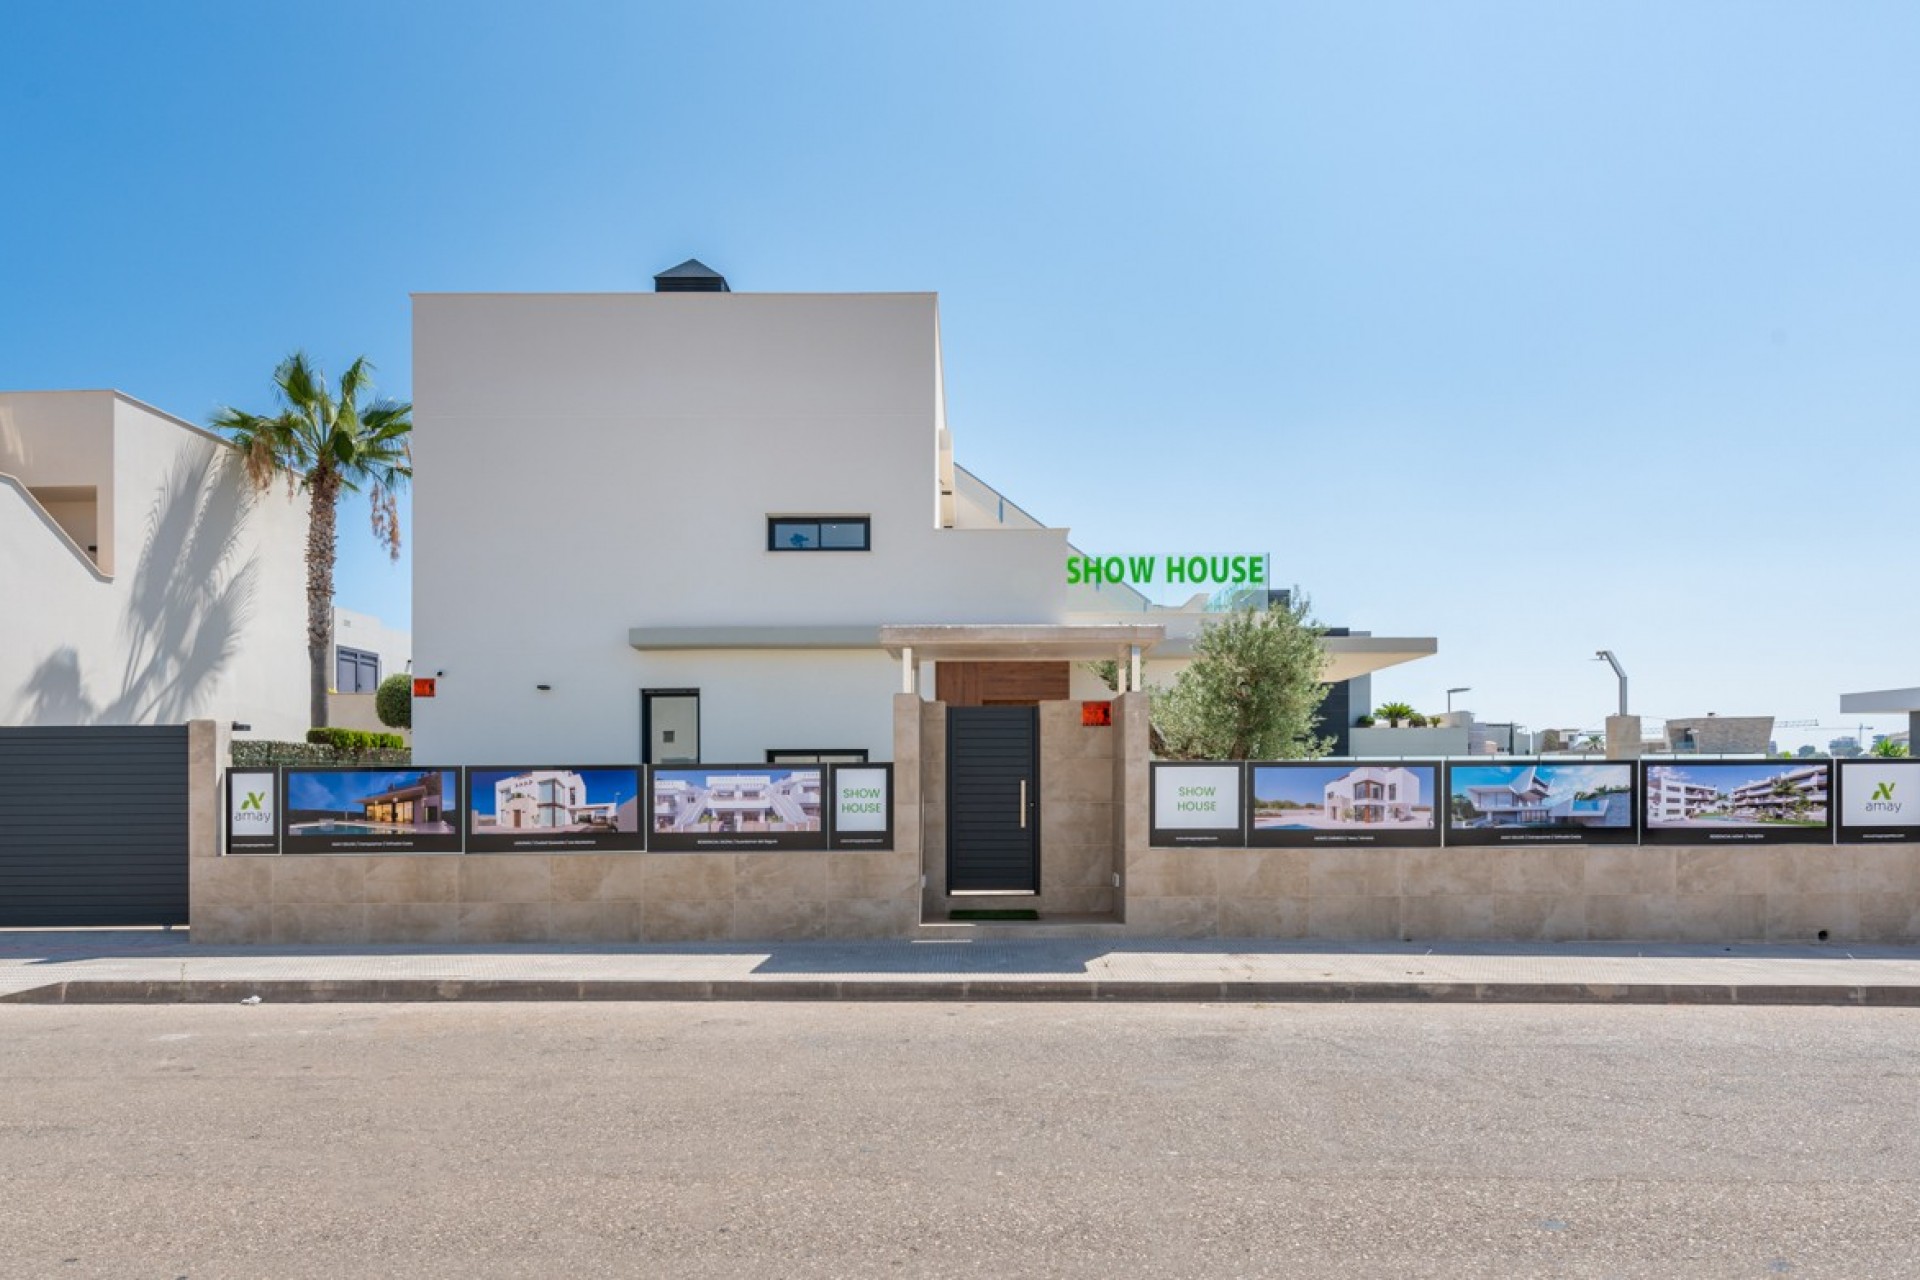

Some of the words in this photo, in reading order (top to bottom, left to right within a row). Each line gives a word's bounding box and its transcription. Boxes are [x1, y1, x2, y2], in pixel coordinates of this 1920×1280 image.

[1066, 555, 1156, 584] SHOW
[1165, 556, 1264, 583] HOUSE
[843, 788, 881, 799] SHOW
[1178, 786, 1217, 797] SHOW
[841, 802, 882, 814] HOUSE
[1177, 801, 1217, 812] HOUSE
[1865, 802, 1903, 814] amay
[233, 812, 271, 824] amay
